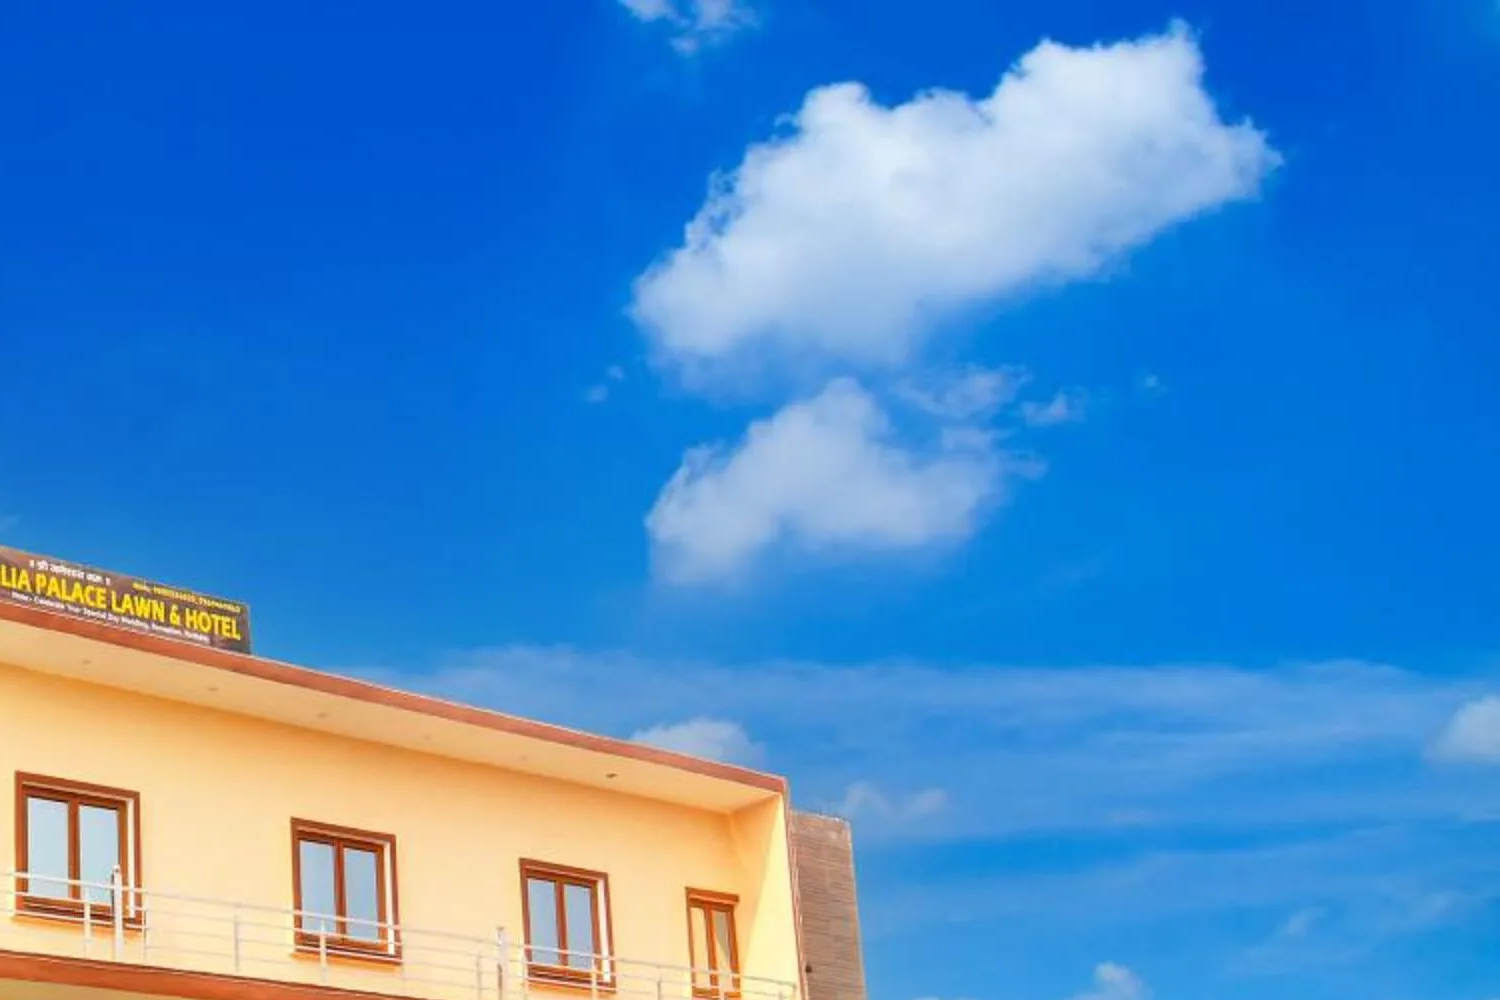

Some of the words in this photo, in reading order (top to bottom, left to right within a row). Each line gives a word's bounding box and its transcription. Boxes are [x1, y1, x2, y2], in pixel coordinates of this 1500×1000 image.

[36, 573, 105, 607] PALACE
[111, 590, 165, 622] LAWN
[169, 603, 180, 626] &
[185, 607, 241, 641] HOTEL
